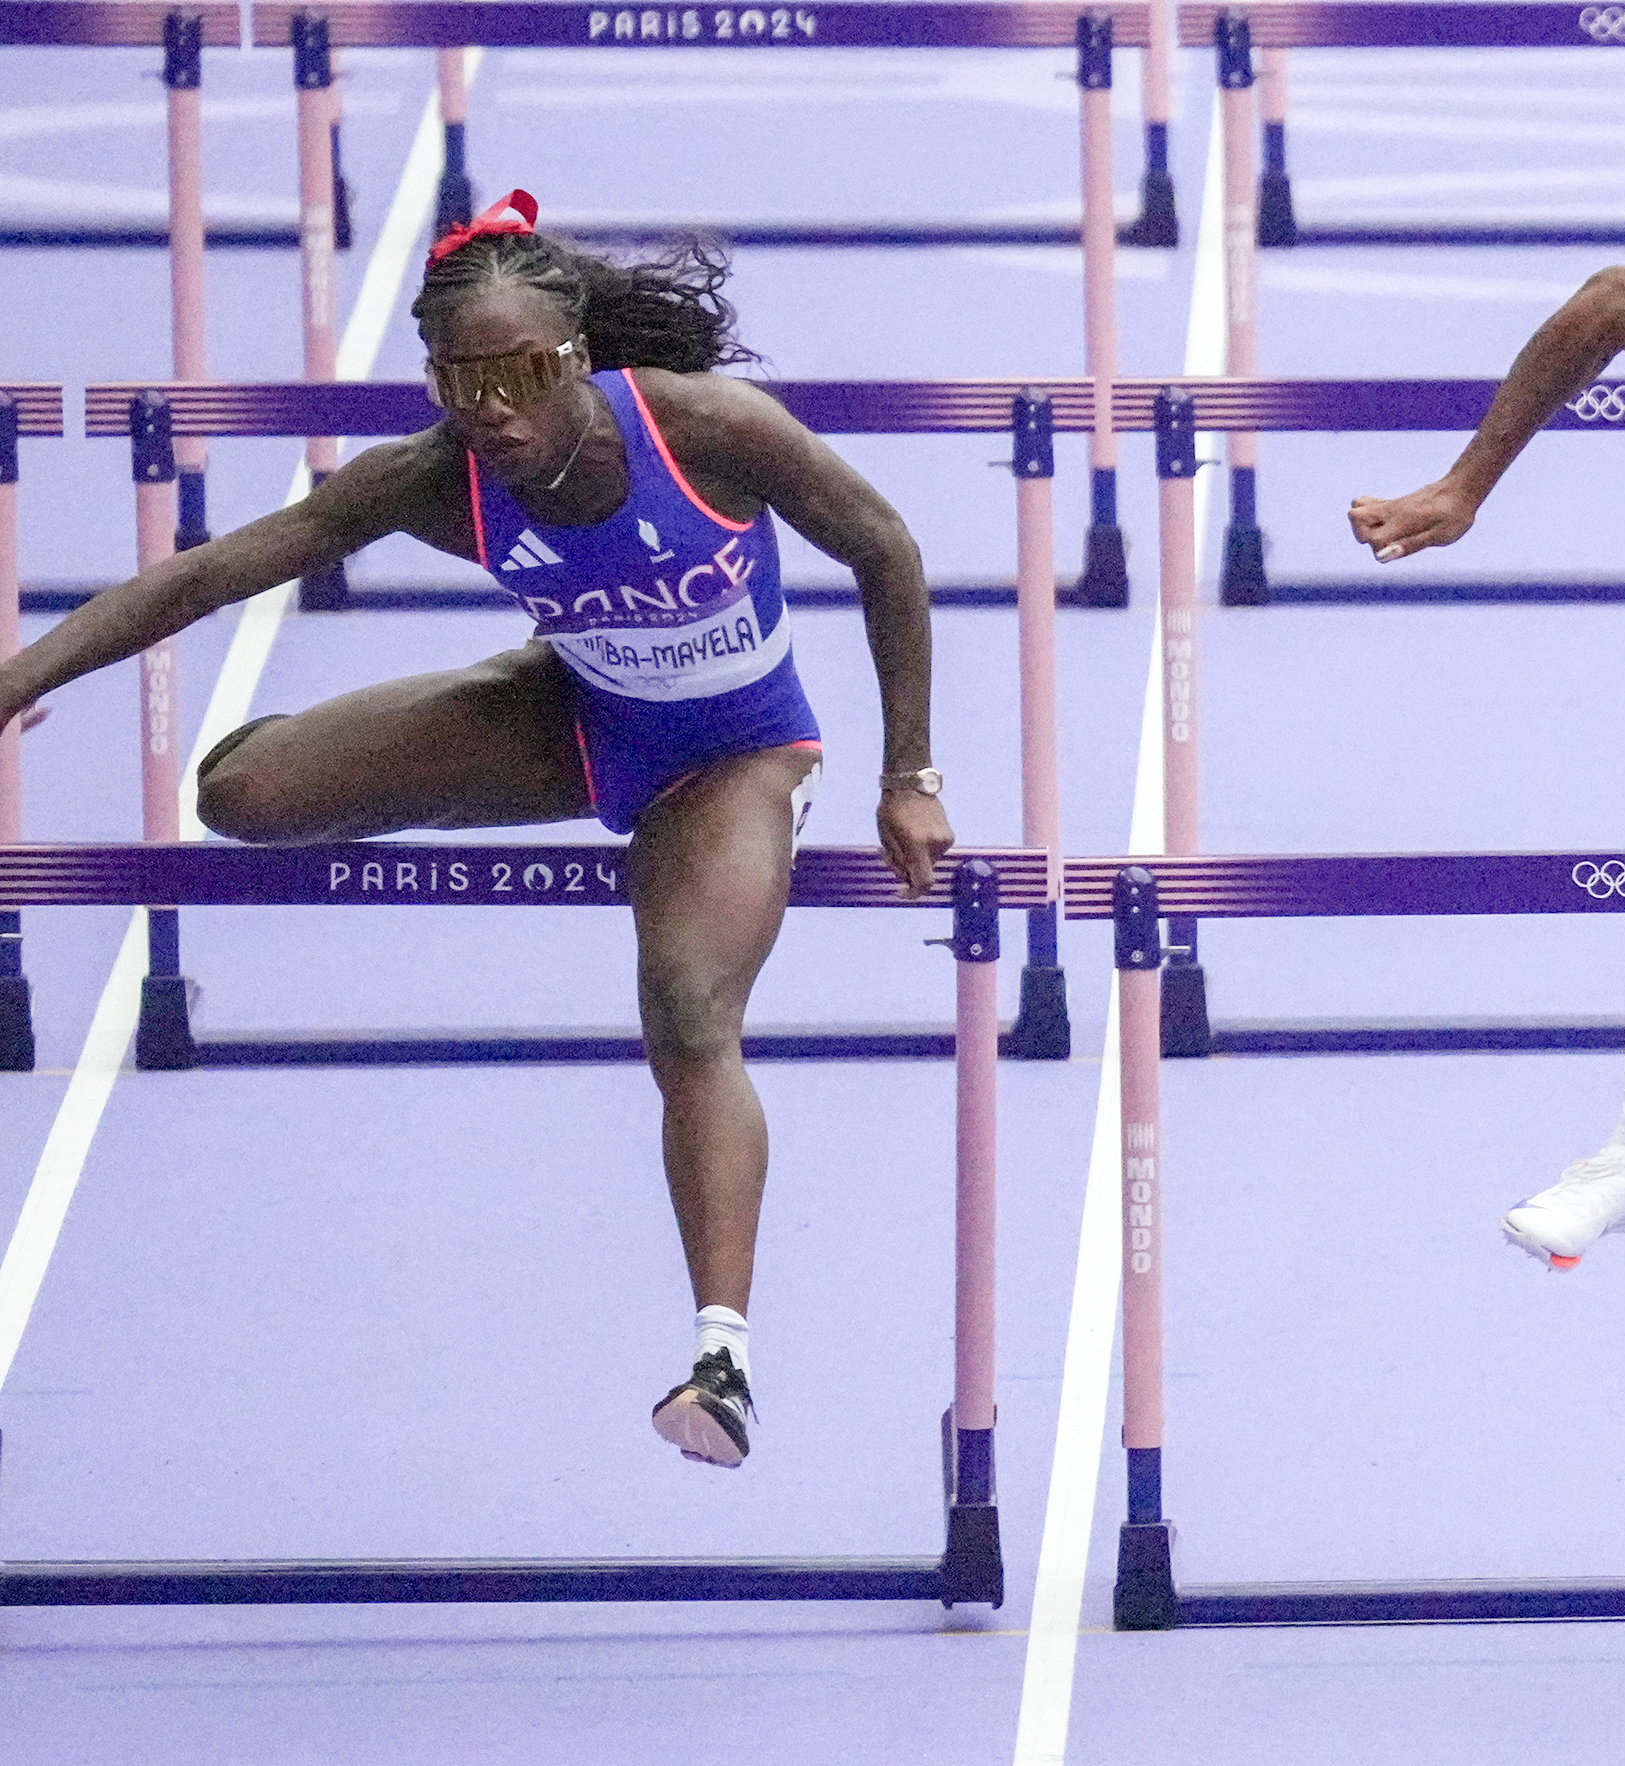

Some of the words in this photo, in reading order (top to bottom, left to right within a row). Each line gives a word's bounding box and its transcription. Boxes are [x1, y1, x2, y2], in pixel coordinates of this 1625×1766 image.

[589, 10, 700, 39] PARIS
[715, 9, 817, 38] 2024
[525, 537, 755, 622] RANCE
[330, 862, 469, 891] PARIS
[491, 862, 617, 891] 2024
[1127, 1157, 1154, 1274] MONDO
